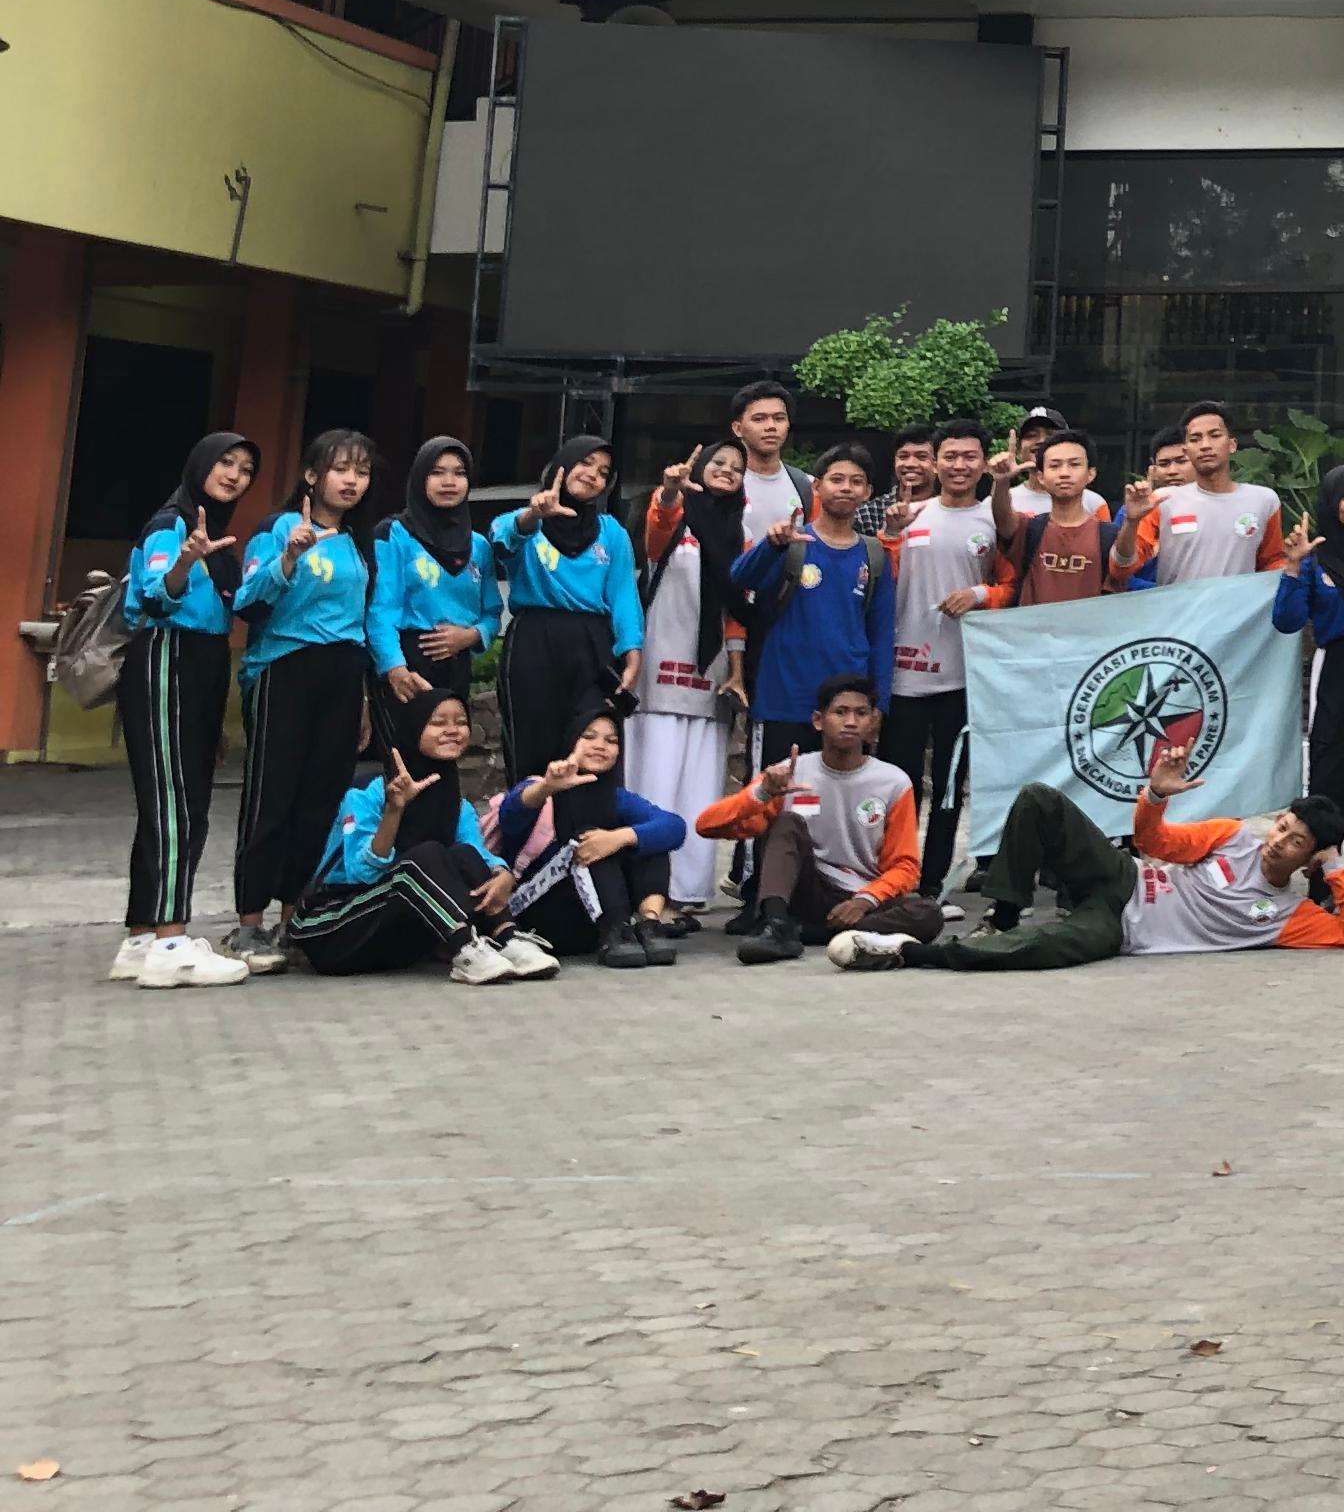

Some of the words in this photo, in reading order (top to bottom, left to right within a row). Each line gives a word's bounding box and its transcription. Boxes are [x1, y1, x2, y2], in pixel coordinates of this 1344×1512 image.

[1073, 654, 1128, 724] GENERASI
[1130, 645, 1193, 666] PECINTA
[1192, 662, 1220, 704] ALAM
[1198, 723, 1219, 760] PARE
